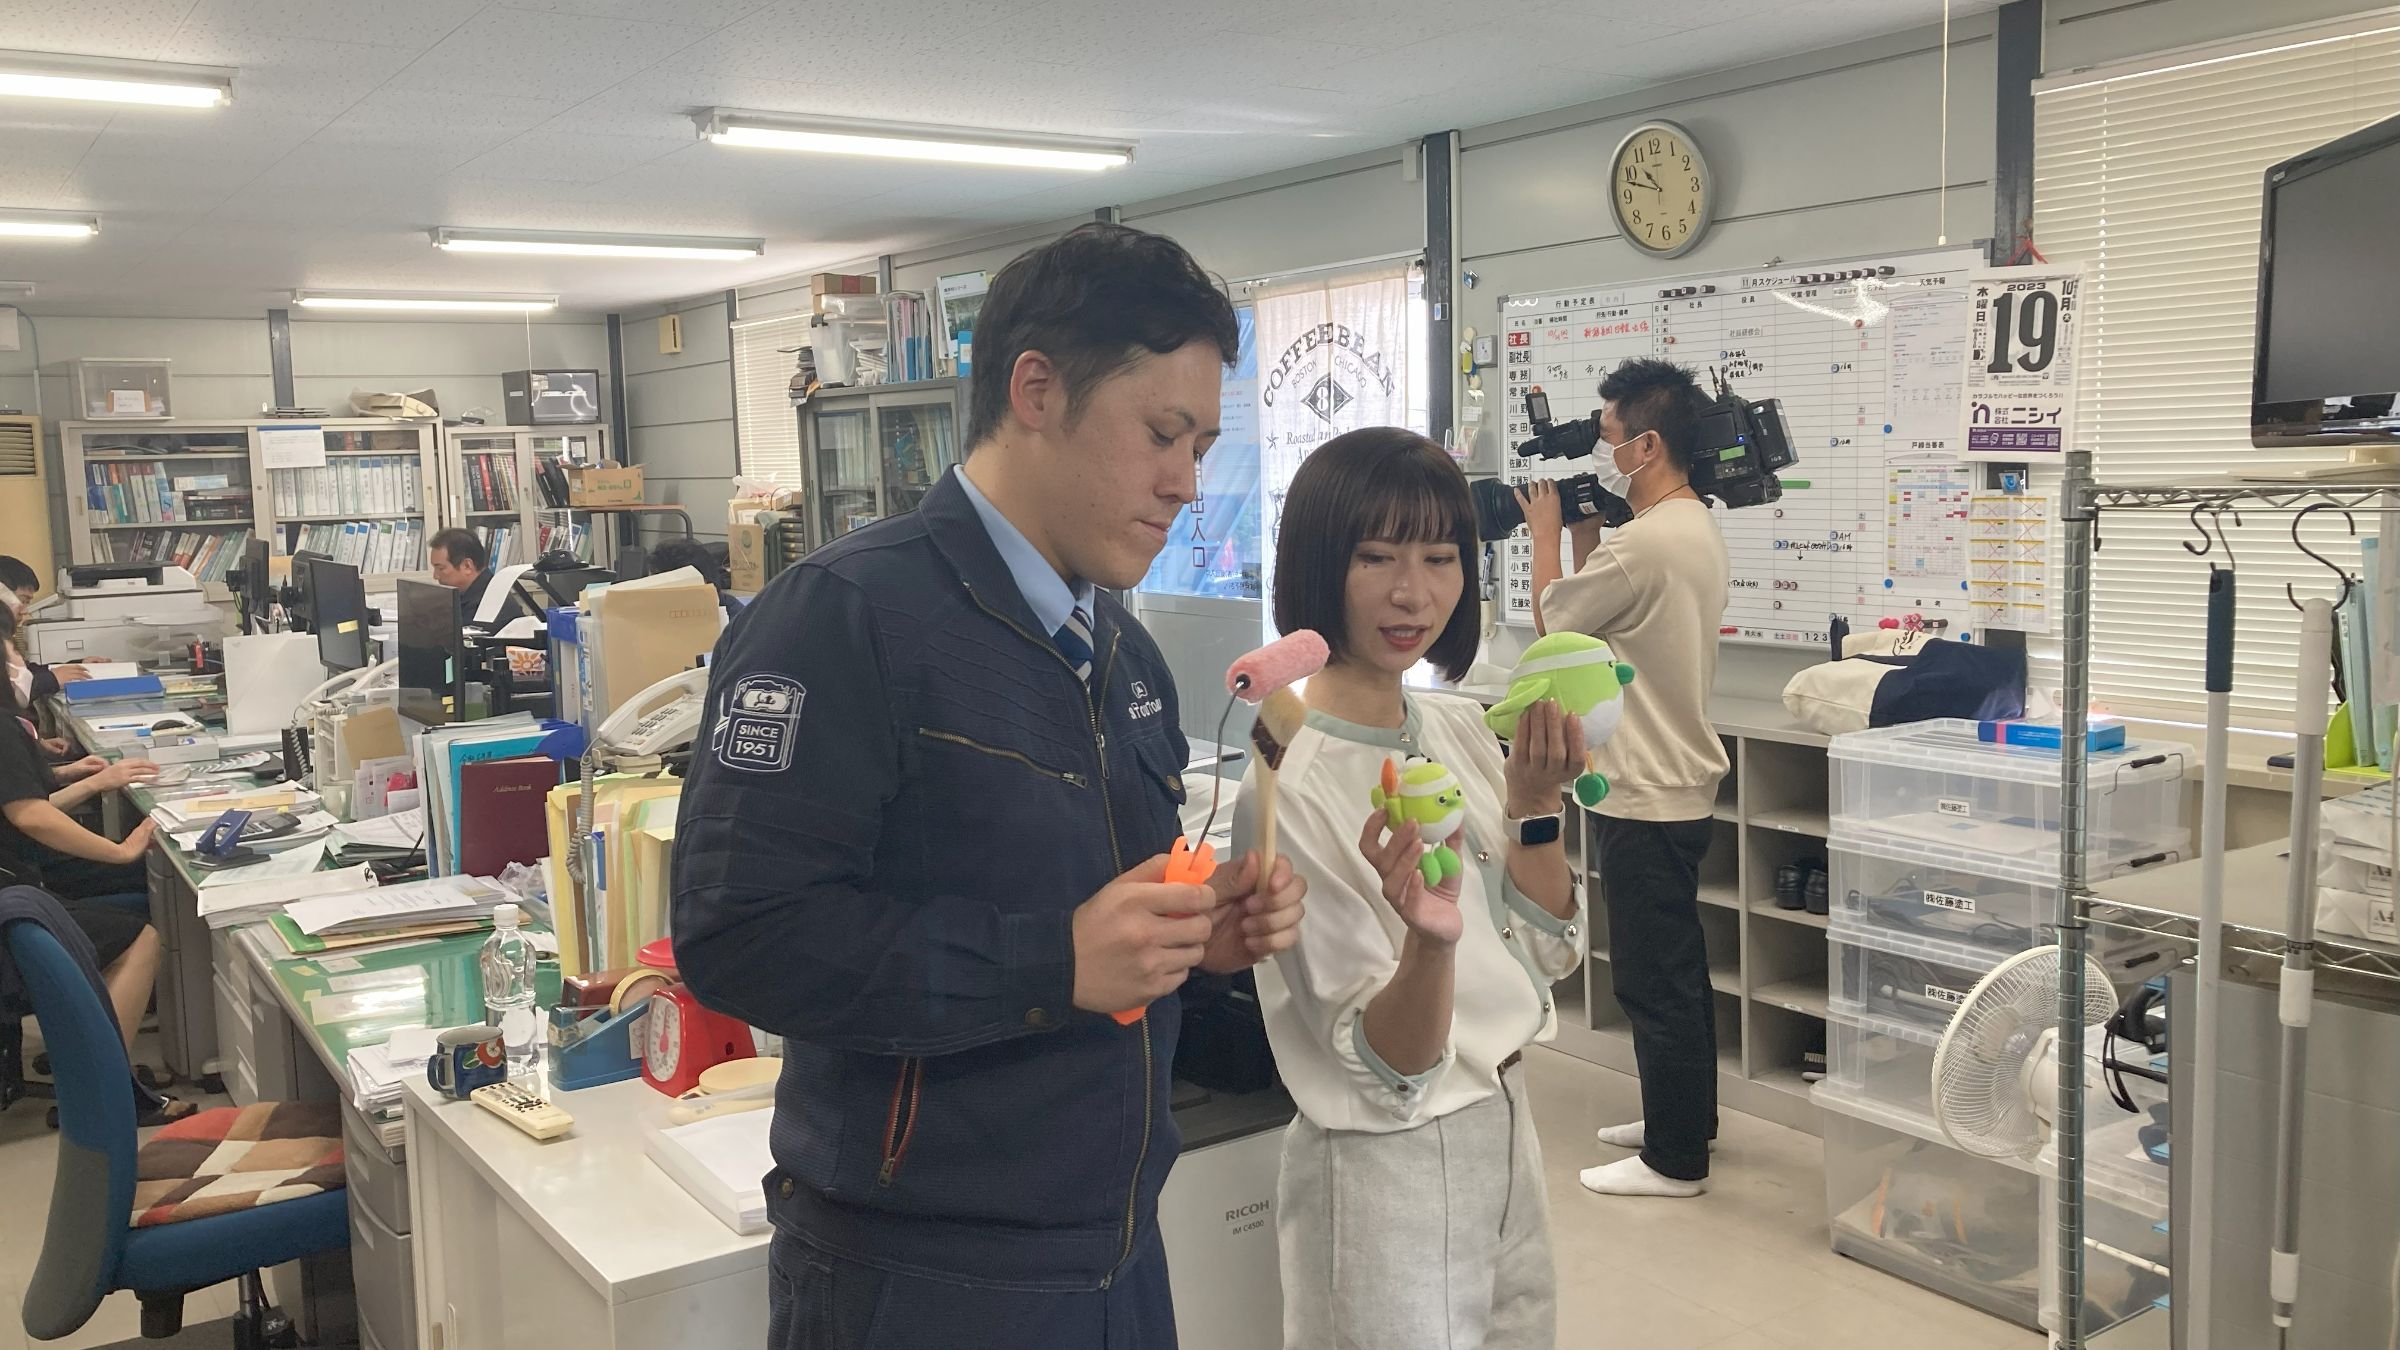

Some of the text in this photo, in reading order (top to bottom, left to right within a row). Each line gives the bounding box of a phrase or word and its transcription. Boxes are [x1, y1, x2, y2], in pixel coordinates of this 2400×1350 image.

[1648, 138, 1661, 155] 12
[1669, 141, 1675, 157] 1
[1634, 147, 1645, 163] 11
[1682, 154, 1691, 171] 2
[1625, 165, 1638, 182] 10
[1690, 176, 1700, 192] 3
[1623, 188, 1633, 205] 9
[1687, 199, 1696, 215] 4
[1632, 209, 1642, 225] 8
[1646, 222, 1654, 239] 7
[1661, 225, 1671, 241] 6
[1679, 218, 1687, 234] 5
[1919, 276, 1946, 287] 天気予報
[2006, 282, 2047, 292] 2023
[1976, 286, 1989, 322] 木曜日
[1508, 333, 1529, 345] 社長
[1987, 290, 2059, 373] 19
[1263, 322, 1395, 408] COFFEE BEAN
[1508, 351, 1530, 364] 副社長
[1509, 370, 1528, 381] 専務
[1509, 422, 1528, 434] 宮田
[1511, 562, 1530, 573] 小野
[1510, 579, 1530, 591] 神野
[738, 724, 780, 738] SINCE
[735, 740, 777, 758] 1951
[1225, 1199, 1270, 1221] RICOH
